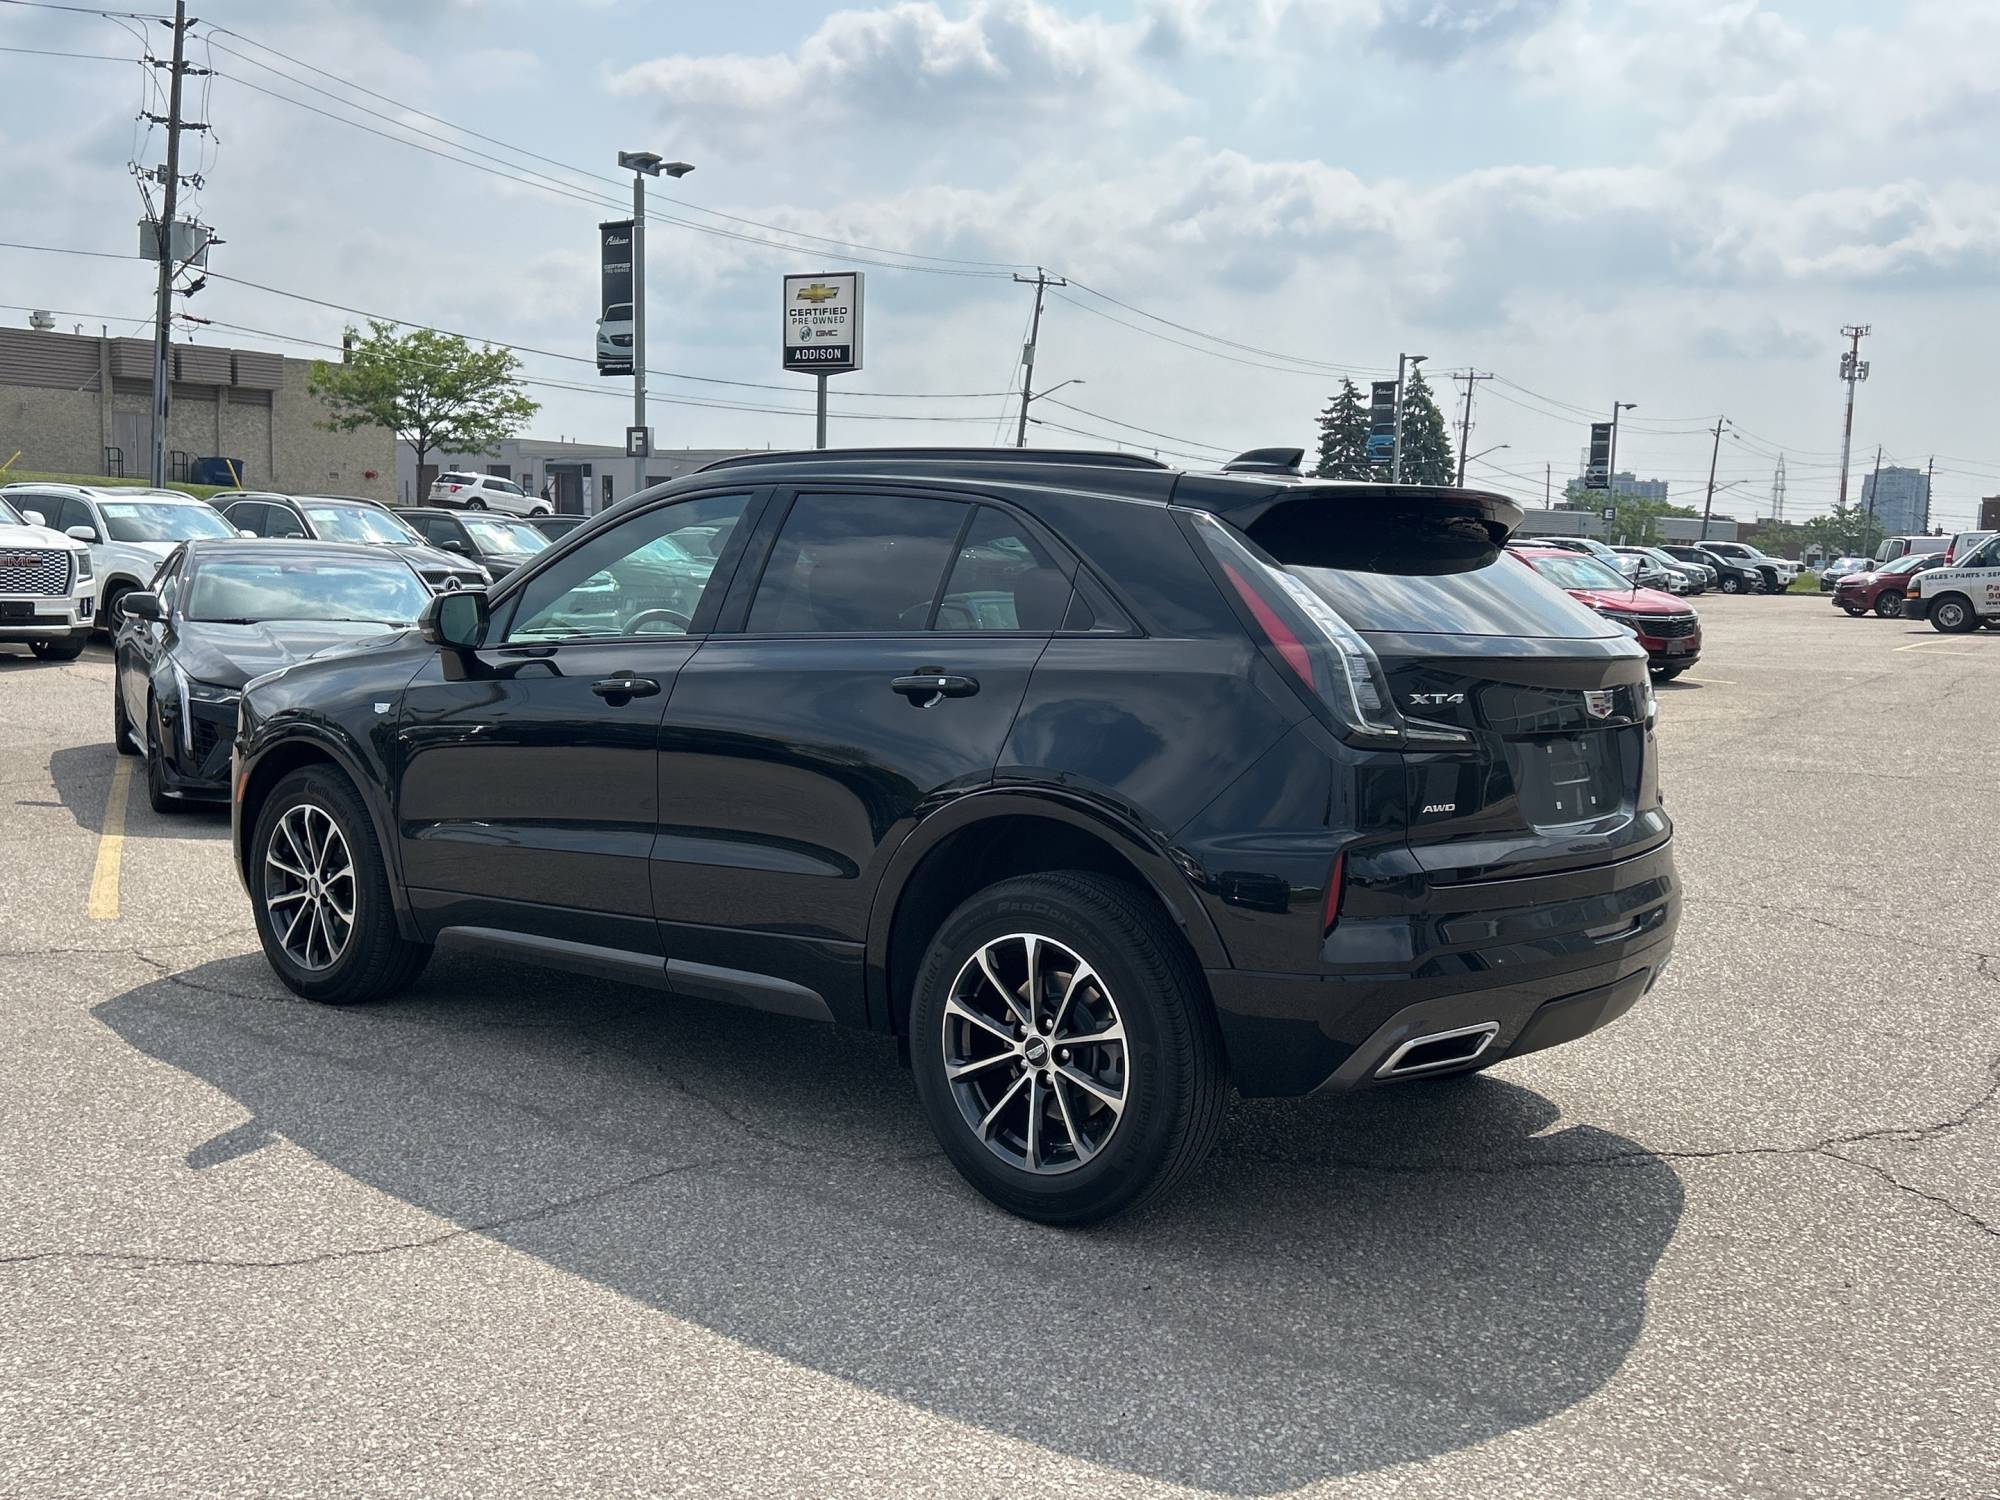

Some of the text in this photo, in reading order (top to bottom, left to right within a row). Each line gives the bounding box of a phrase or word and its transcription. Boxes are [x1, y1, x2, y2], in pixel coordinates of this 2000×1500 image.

[789, 307, 848, 317] CERTIFIED
[792, 316, 845, 325] PRE-OWNED
[794, 348, 841, 360] ADDISON
[631, 431, 644, 452] F
[1605, 509, 1614, 519] E
[1409, 693, 1464, 705] XT4
[1422, 803, 1456, 814] AWD
